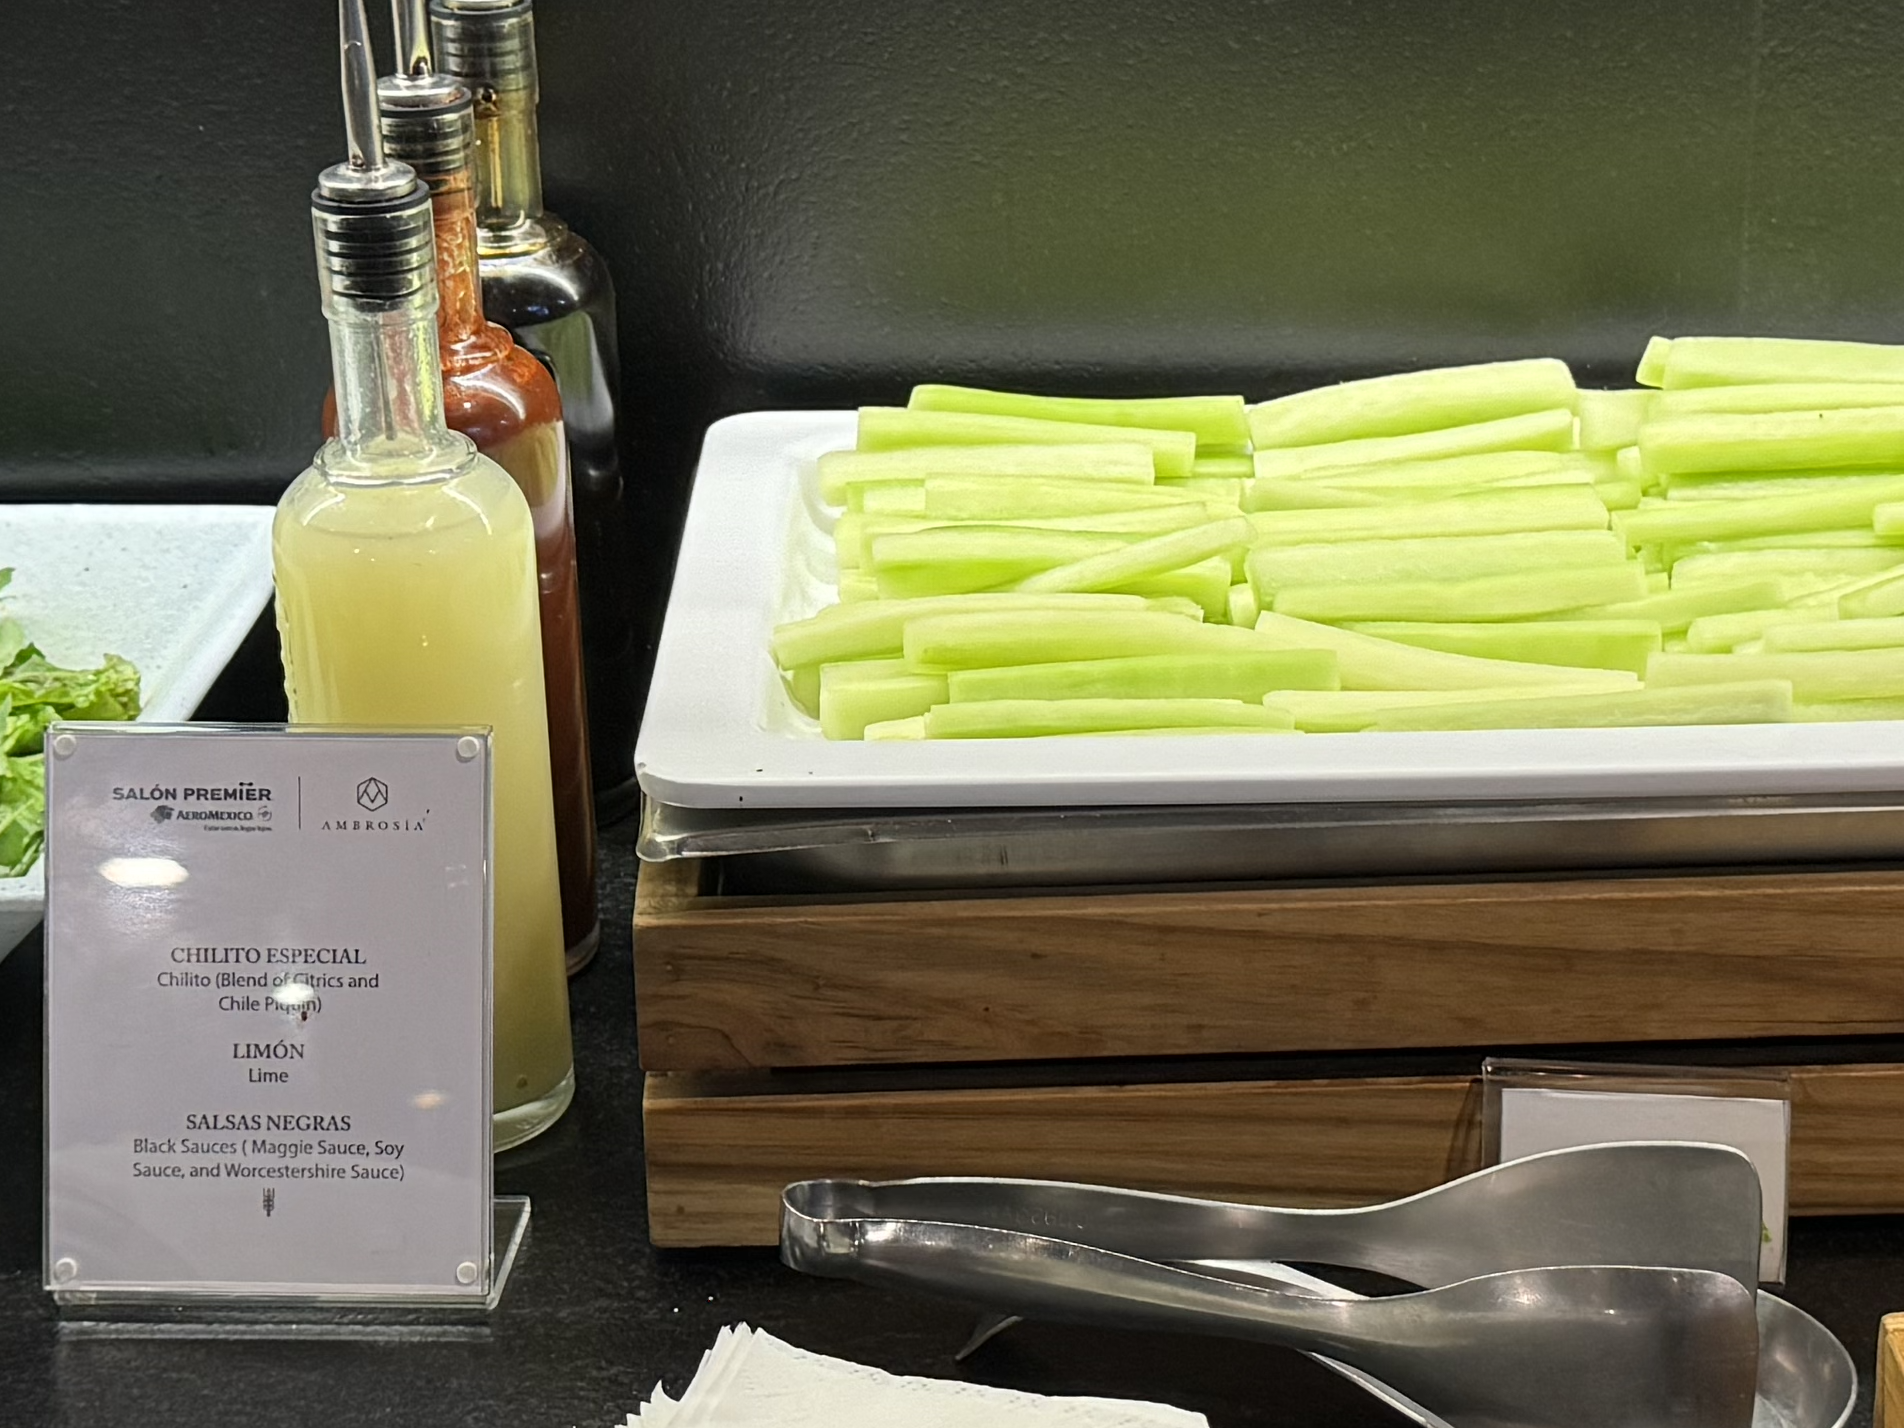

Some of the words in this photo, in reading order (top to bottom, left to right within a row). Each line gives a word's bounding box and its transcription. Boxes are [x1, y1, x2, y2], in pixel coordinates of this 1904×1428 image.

[112, 783, 178, 801] SALÓN
[171, 947, 261, 965] CHILITO
[266, 947, 367, 965] ESPECIAL
[157, 971, 211, 987] Chilito
[215, 973, 268, 989] (Blend
[272, 972, 289, 987] of
[293, 973, 343, 988] Citrics
[348, 973, 379, 988] and
[218, 996, 260, 1011] Chile
[231, 1040, 306, 1060] LIMÓN
[248, 1067, 289, 1085] Lime
[186, 1114, 261, 1131] SALSAS
[266, 1116, 351, 1132] NEGRAS
[133, 1139, 176, 1154] Black
[181, 1139, 237, 1154] Sauces
[252, 1140, 312, 1158] Maggie
[318, 1140, 370, 1157] Sauce,
[374, 1141, 405, 1159] Soy
[133, 1162, 185, 1179] Sauce,
[190, 1164, 220, 1177] and
[224, 1164, 346, 1179] Worcestershire
[350, 1164, 404, 1181] Sauce)
